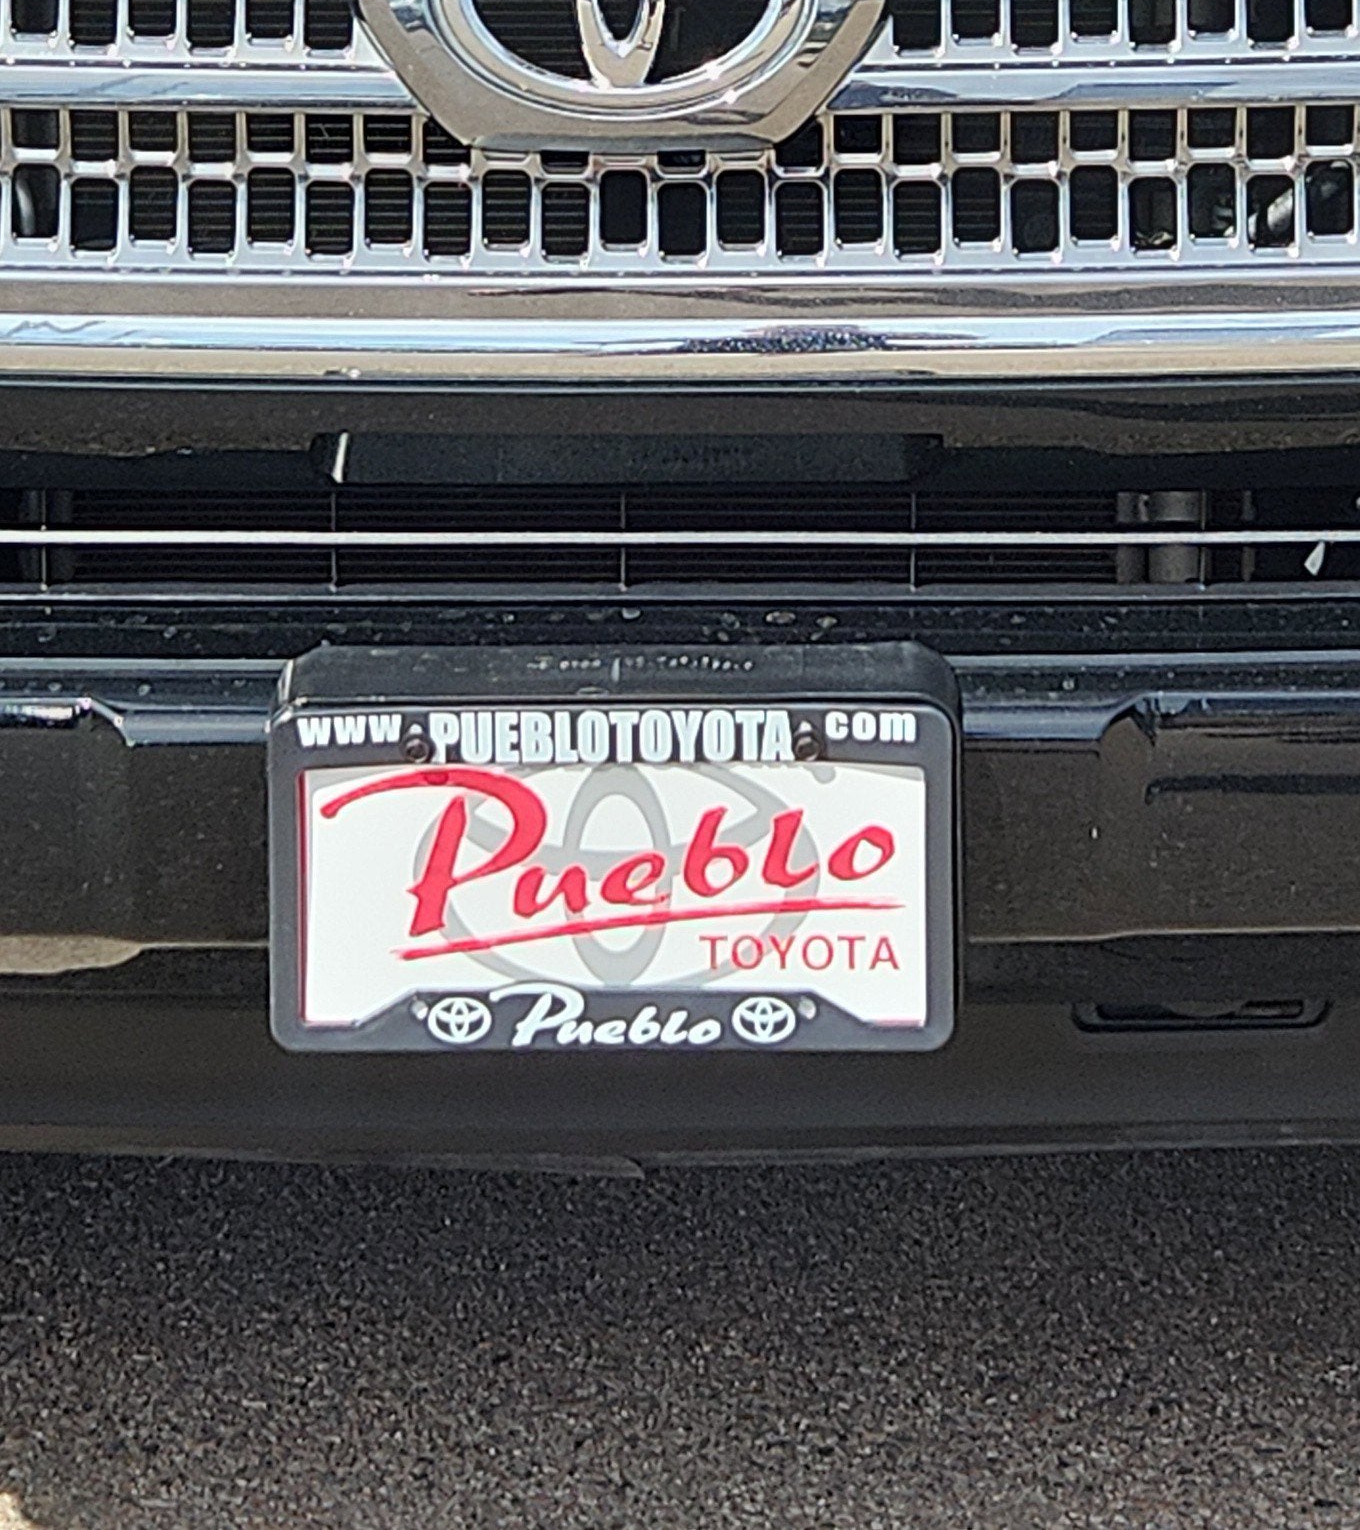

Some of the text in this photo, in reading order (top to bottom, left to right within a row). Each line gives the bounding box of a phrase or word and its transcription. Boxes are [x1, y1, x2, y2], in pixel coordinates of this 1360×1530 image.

[320, 767, 896, 937] Pueblo
[699, 934, 900, 970] TOYOTA
[489, 981, 722, 1047] Pueblo
